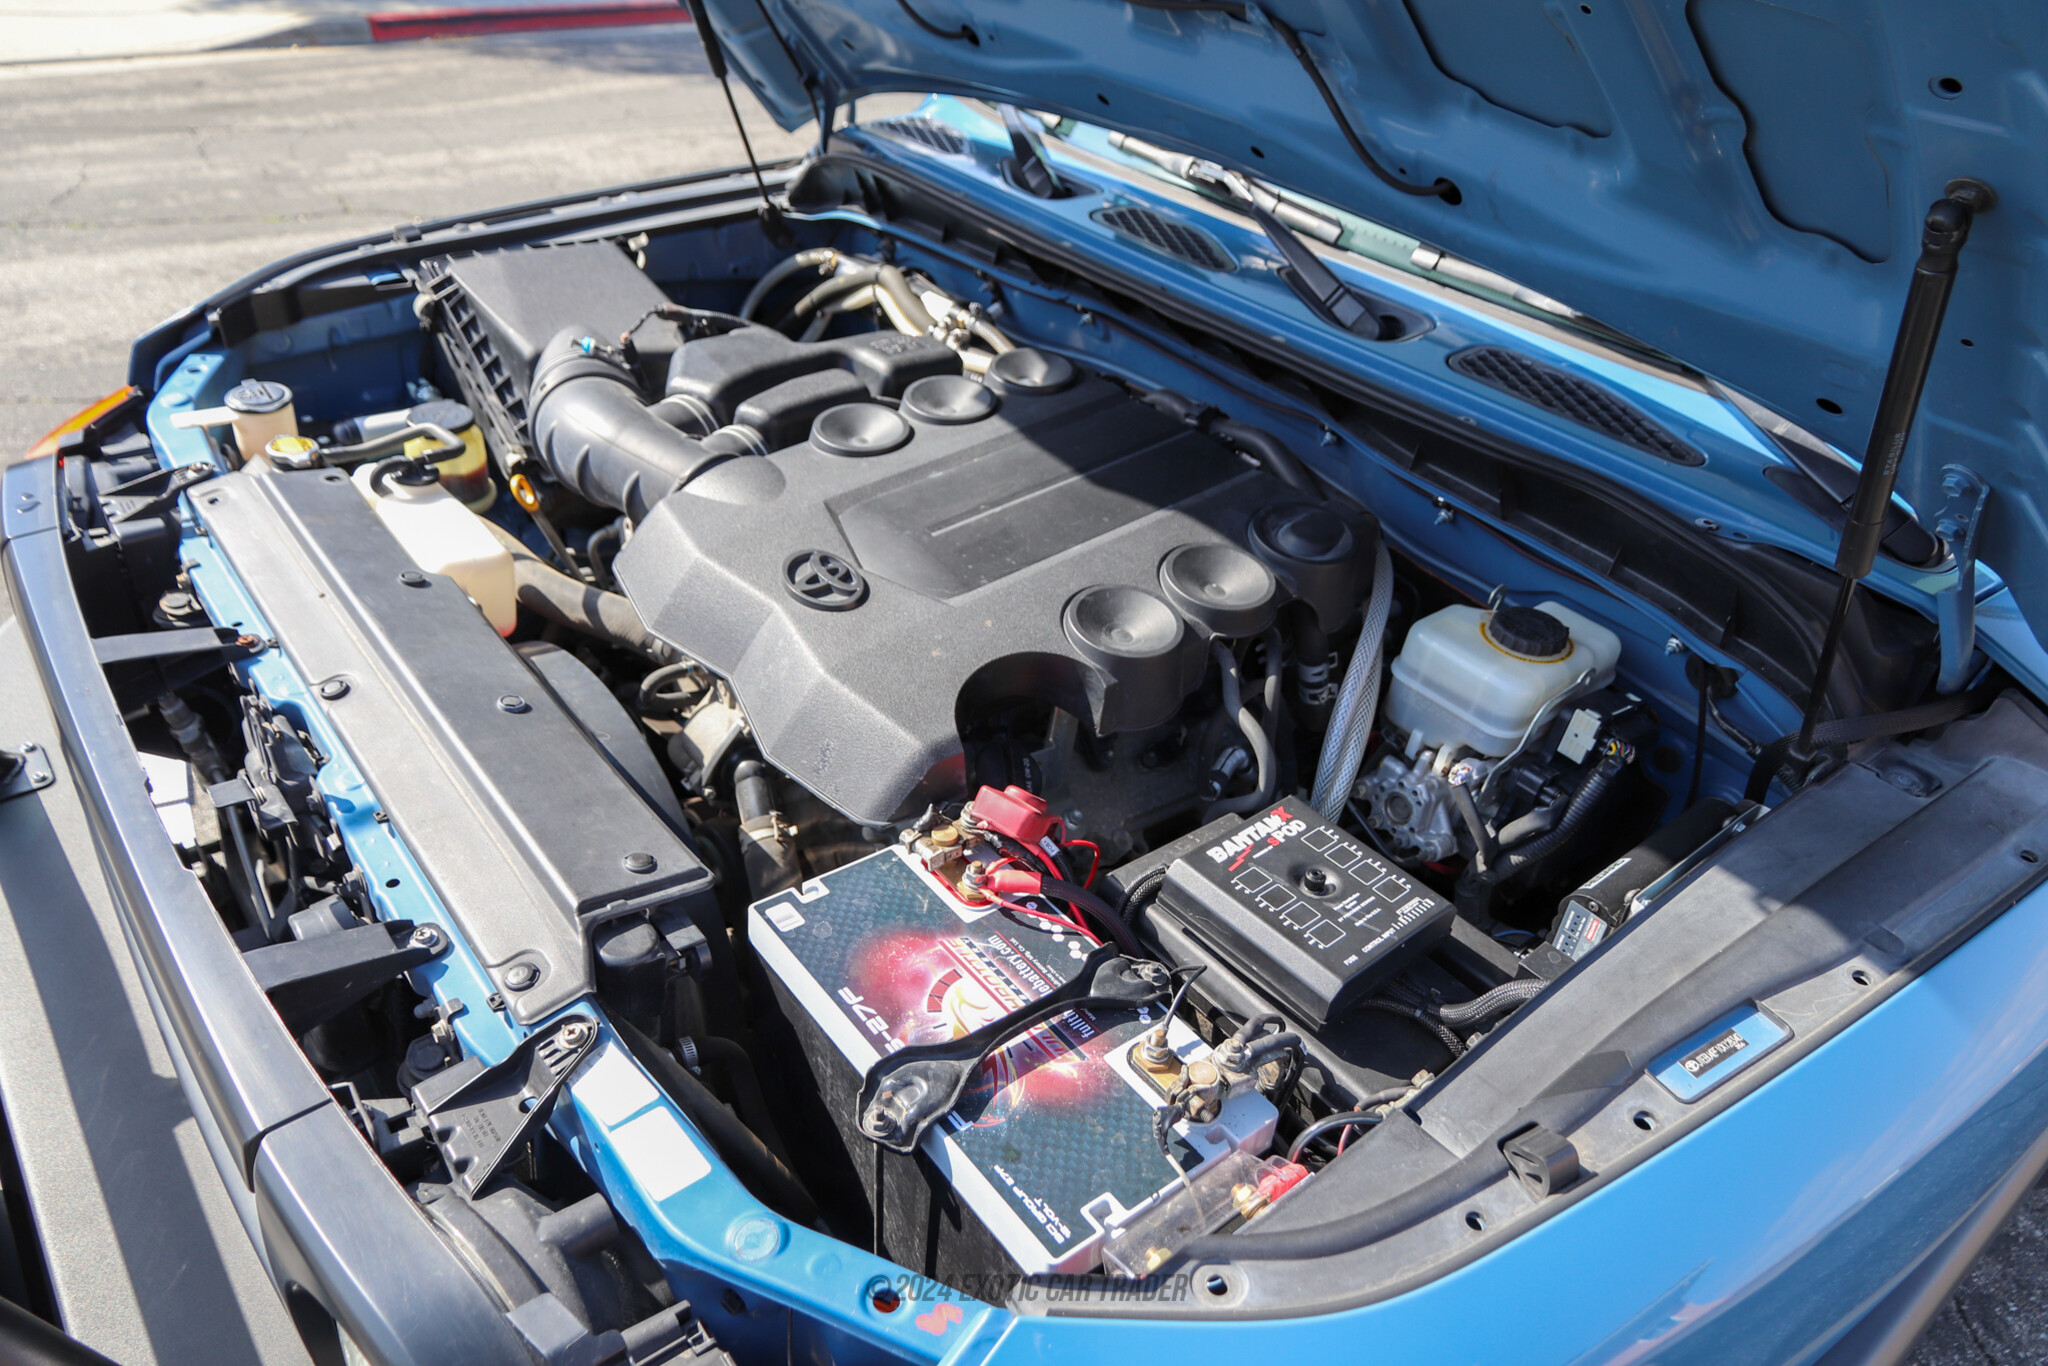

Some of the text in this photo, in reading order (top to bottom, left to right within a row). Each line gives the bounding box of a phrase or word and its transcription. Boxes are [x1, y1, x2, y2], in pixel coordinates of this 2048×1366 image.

[946, 939, 1025, 1009] HROTTLE
[1343, 954, 1359, 967] FUSE
[1013, 1186, 1048, 1224] GROUP
